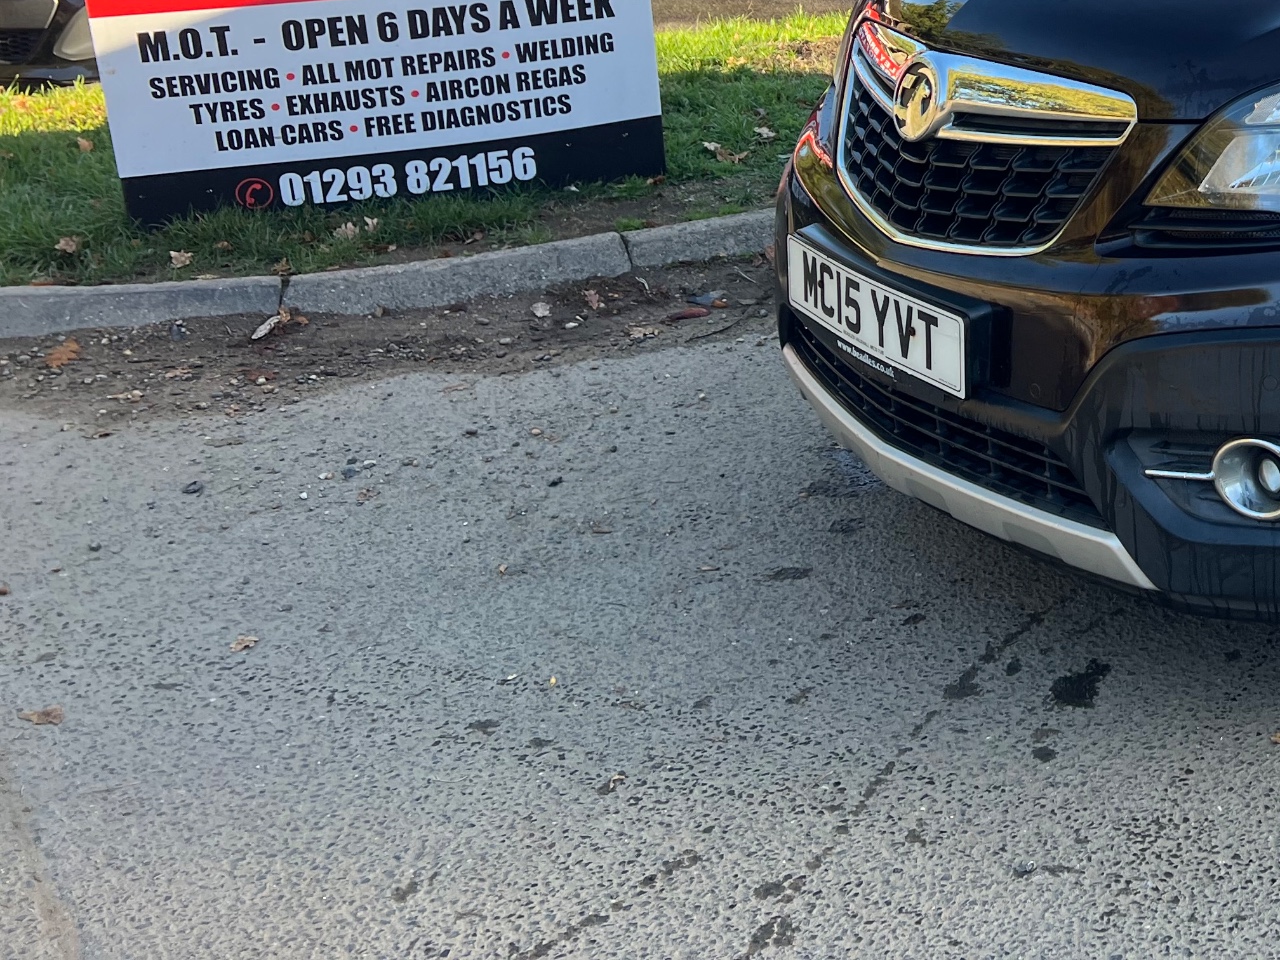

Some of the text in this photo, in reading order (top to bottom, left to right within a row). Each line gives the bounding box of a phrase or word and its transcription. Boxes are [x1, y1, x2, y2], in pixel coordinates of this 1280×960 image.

[137, 25, 238, 63] M.O.T.
[281, 14, 369, 51] OPEN
[377, 11, 399, 43] 6
[407, 2, 491, 40] DAYS
[499, 0, 520, 31] A
[149, 32, 614, 99] SERVICING ALL MOT REPAIRS WELDING
[189, 64, 586, 124] TYRES EXHAUSTS AIRCON REGAS
[215, 93, 572, 151] LOAN CARS FREE DIAGNOSTICS
[278, 146, 537, 207] 01293 821156
[802, 250, 938, 371] MC15 YVT
